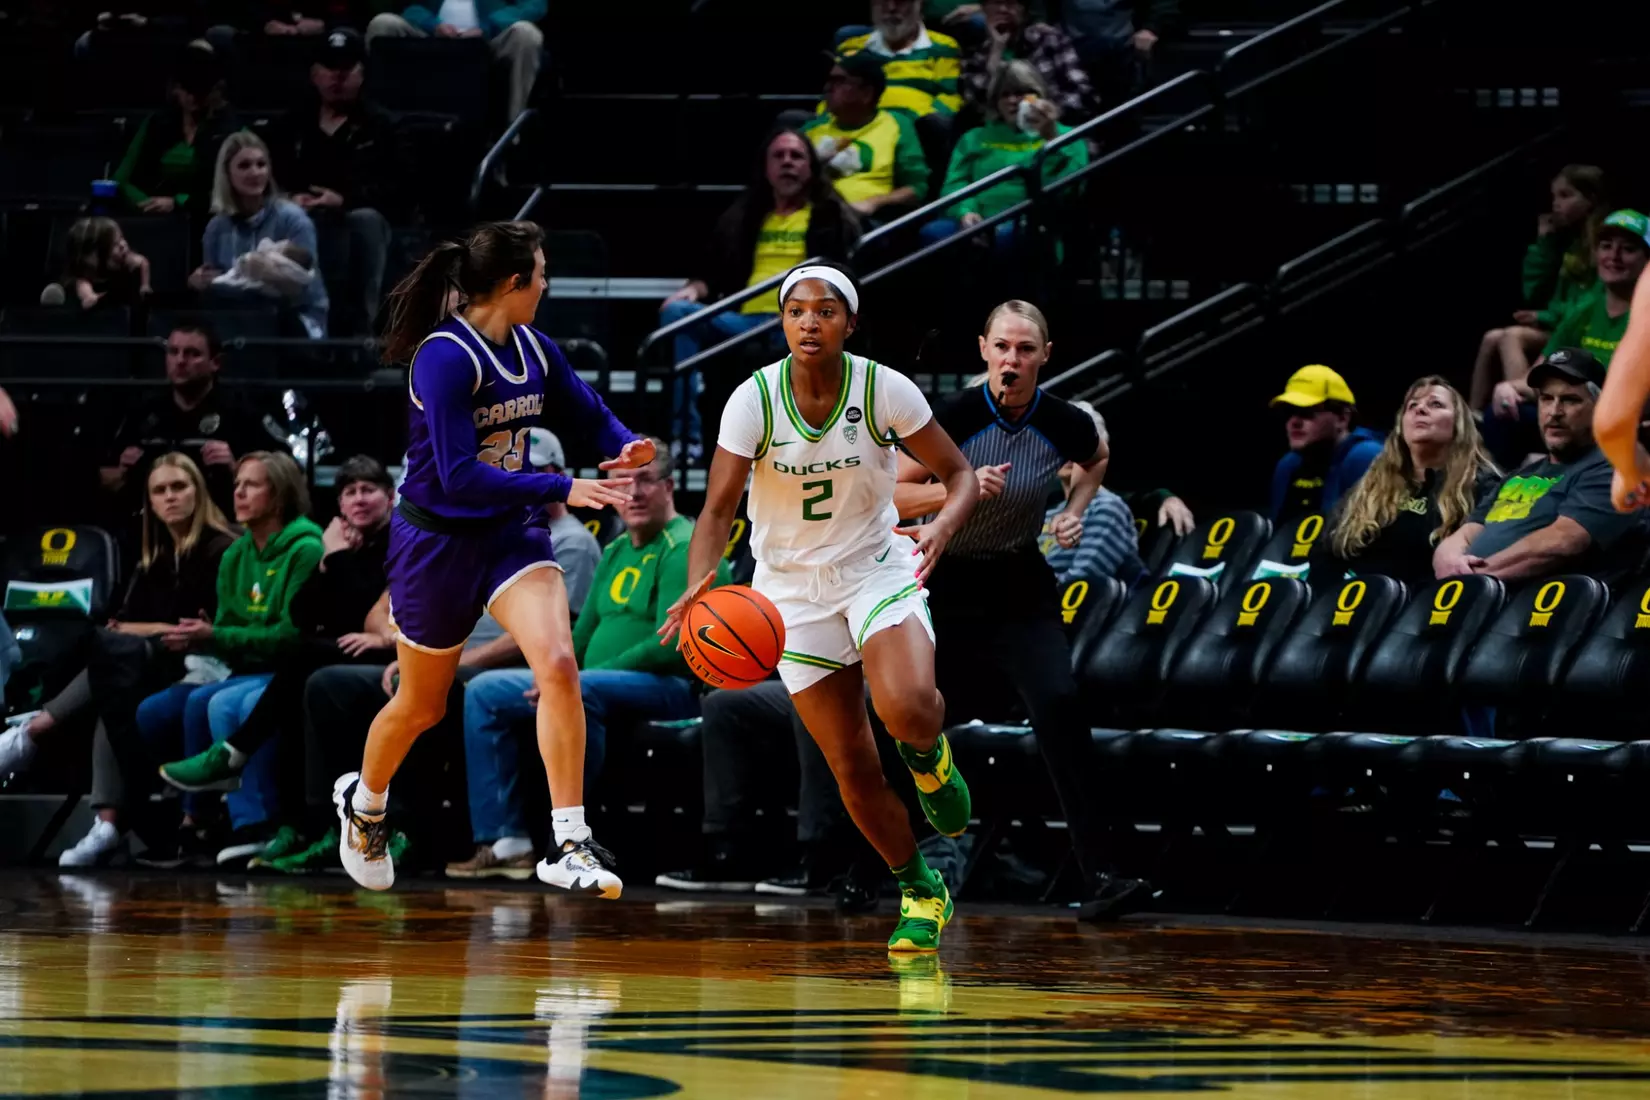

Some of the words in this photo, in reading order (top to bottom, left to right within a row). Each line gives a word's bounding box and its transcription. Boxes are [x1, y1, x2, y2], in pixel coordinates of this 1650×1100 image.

[773, 455, 861, 476] DUCKS
[802, 479, 833, 521] 2
[609, 566, 642, 605] O
[683, 640, 725, 684] ELITE
